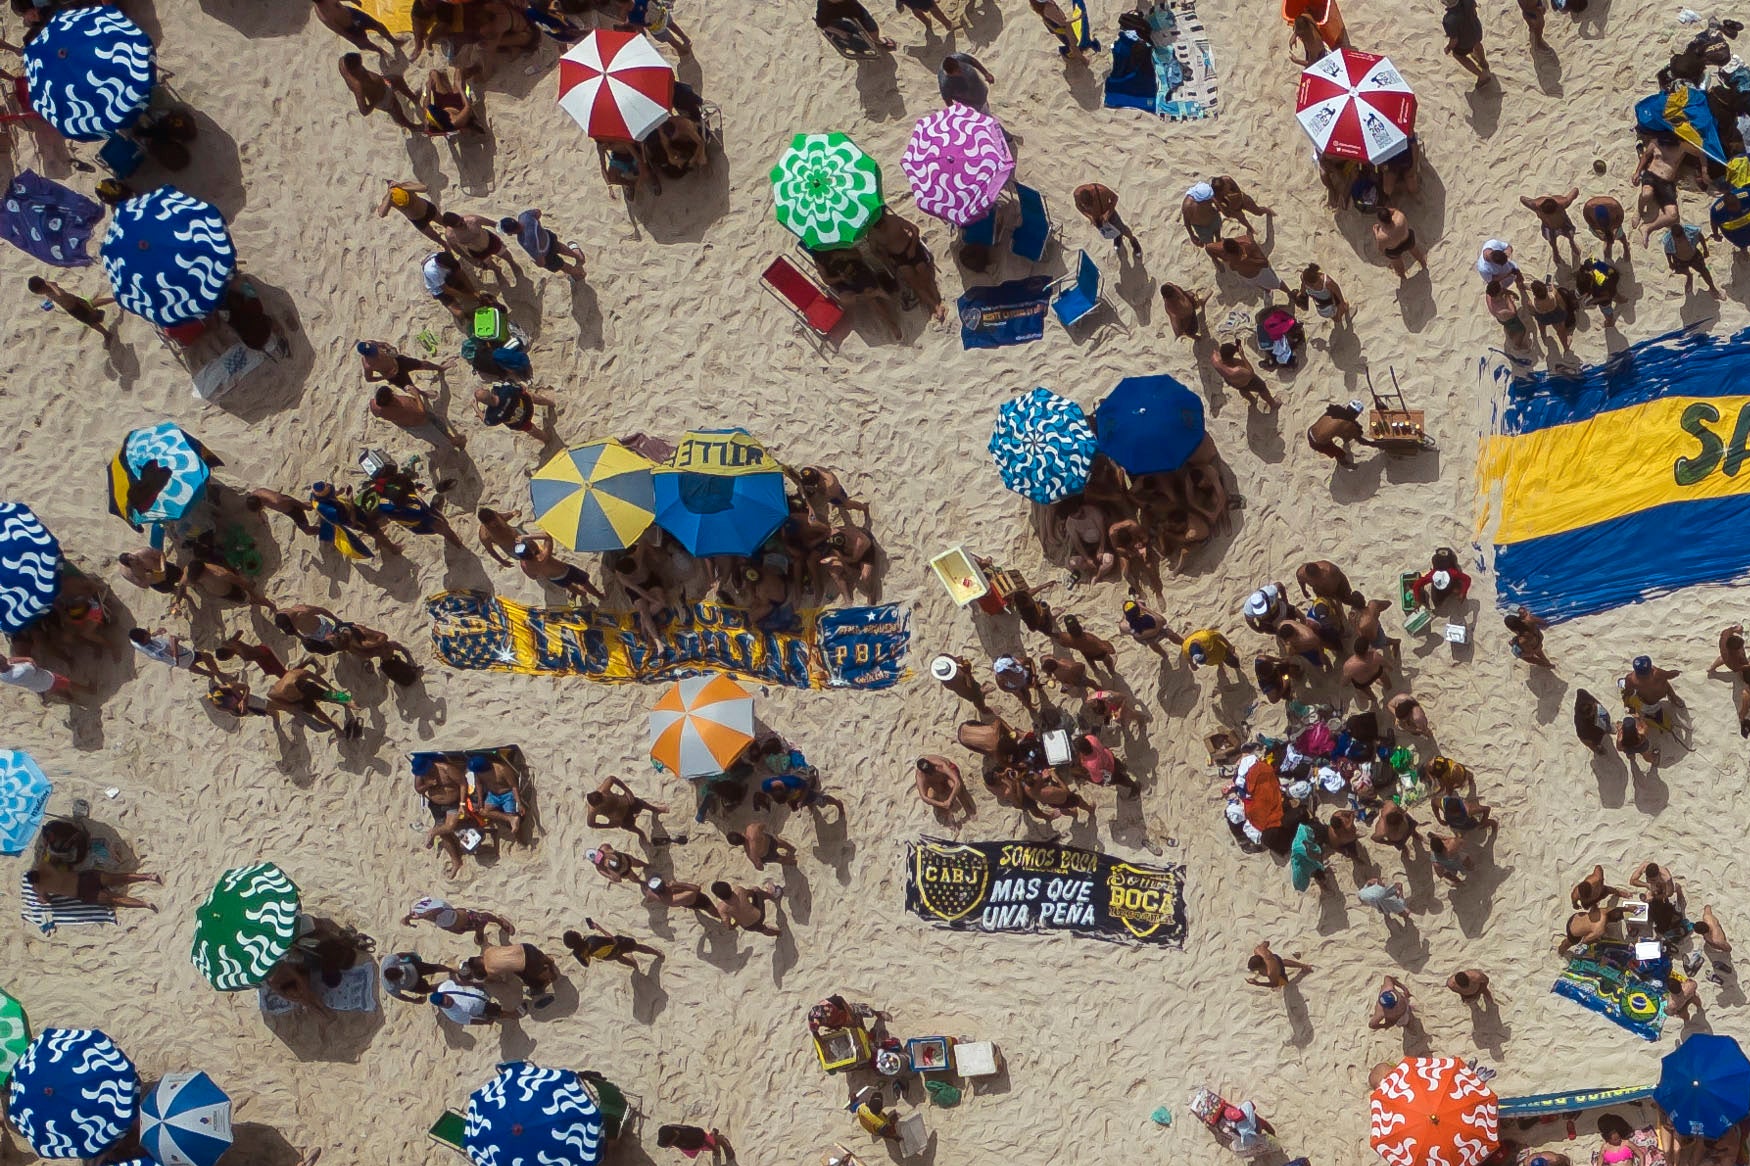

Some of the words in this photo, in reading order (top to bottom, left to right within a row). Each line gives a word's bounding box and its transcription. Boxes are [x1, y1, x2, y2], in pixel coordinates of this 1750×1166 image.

[1000, 845, 1055, 867] SOMOS
[1060, 850, 1098, 873] BOCA
[925, 867, 977, 883] CABJ
[990, 878, 1041, 902] MAS
[1047, 877, 1094, 903] QUE
[1109, 885, 1175, 915] BOCA
[982, 905, 1029, 932] UNA
[1039, 902, 1095, 926] PEÑA
